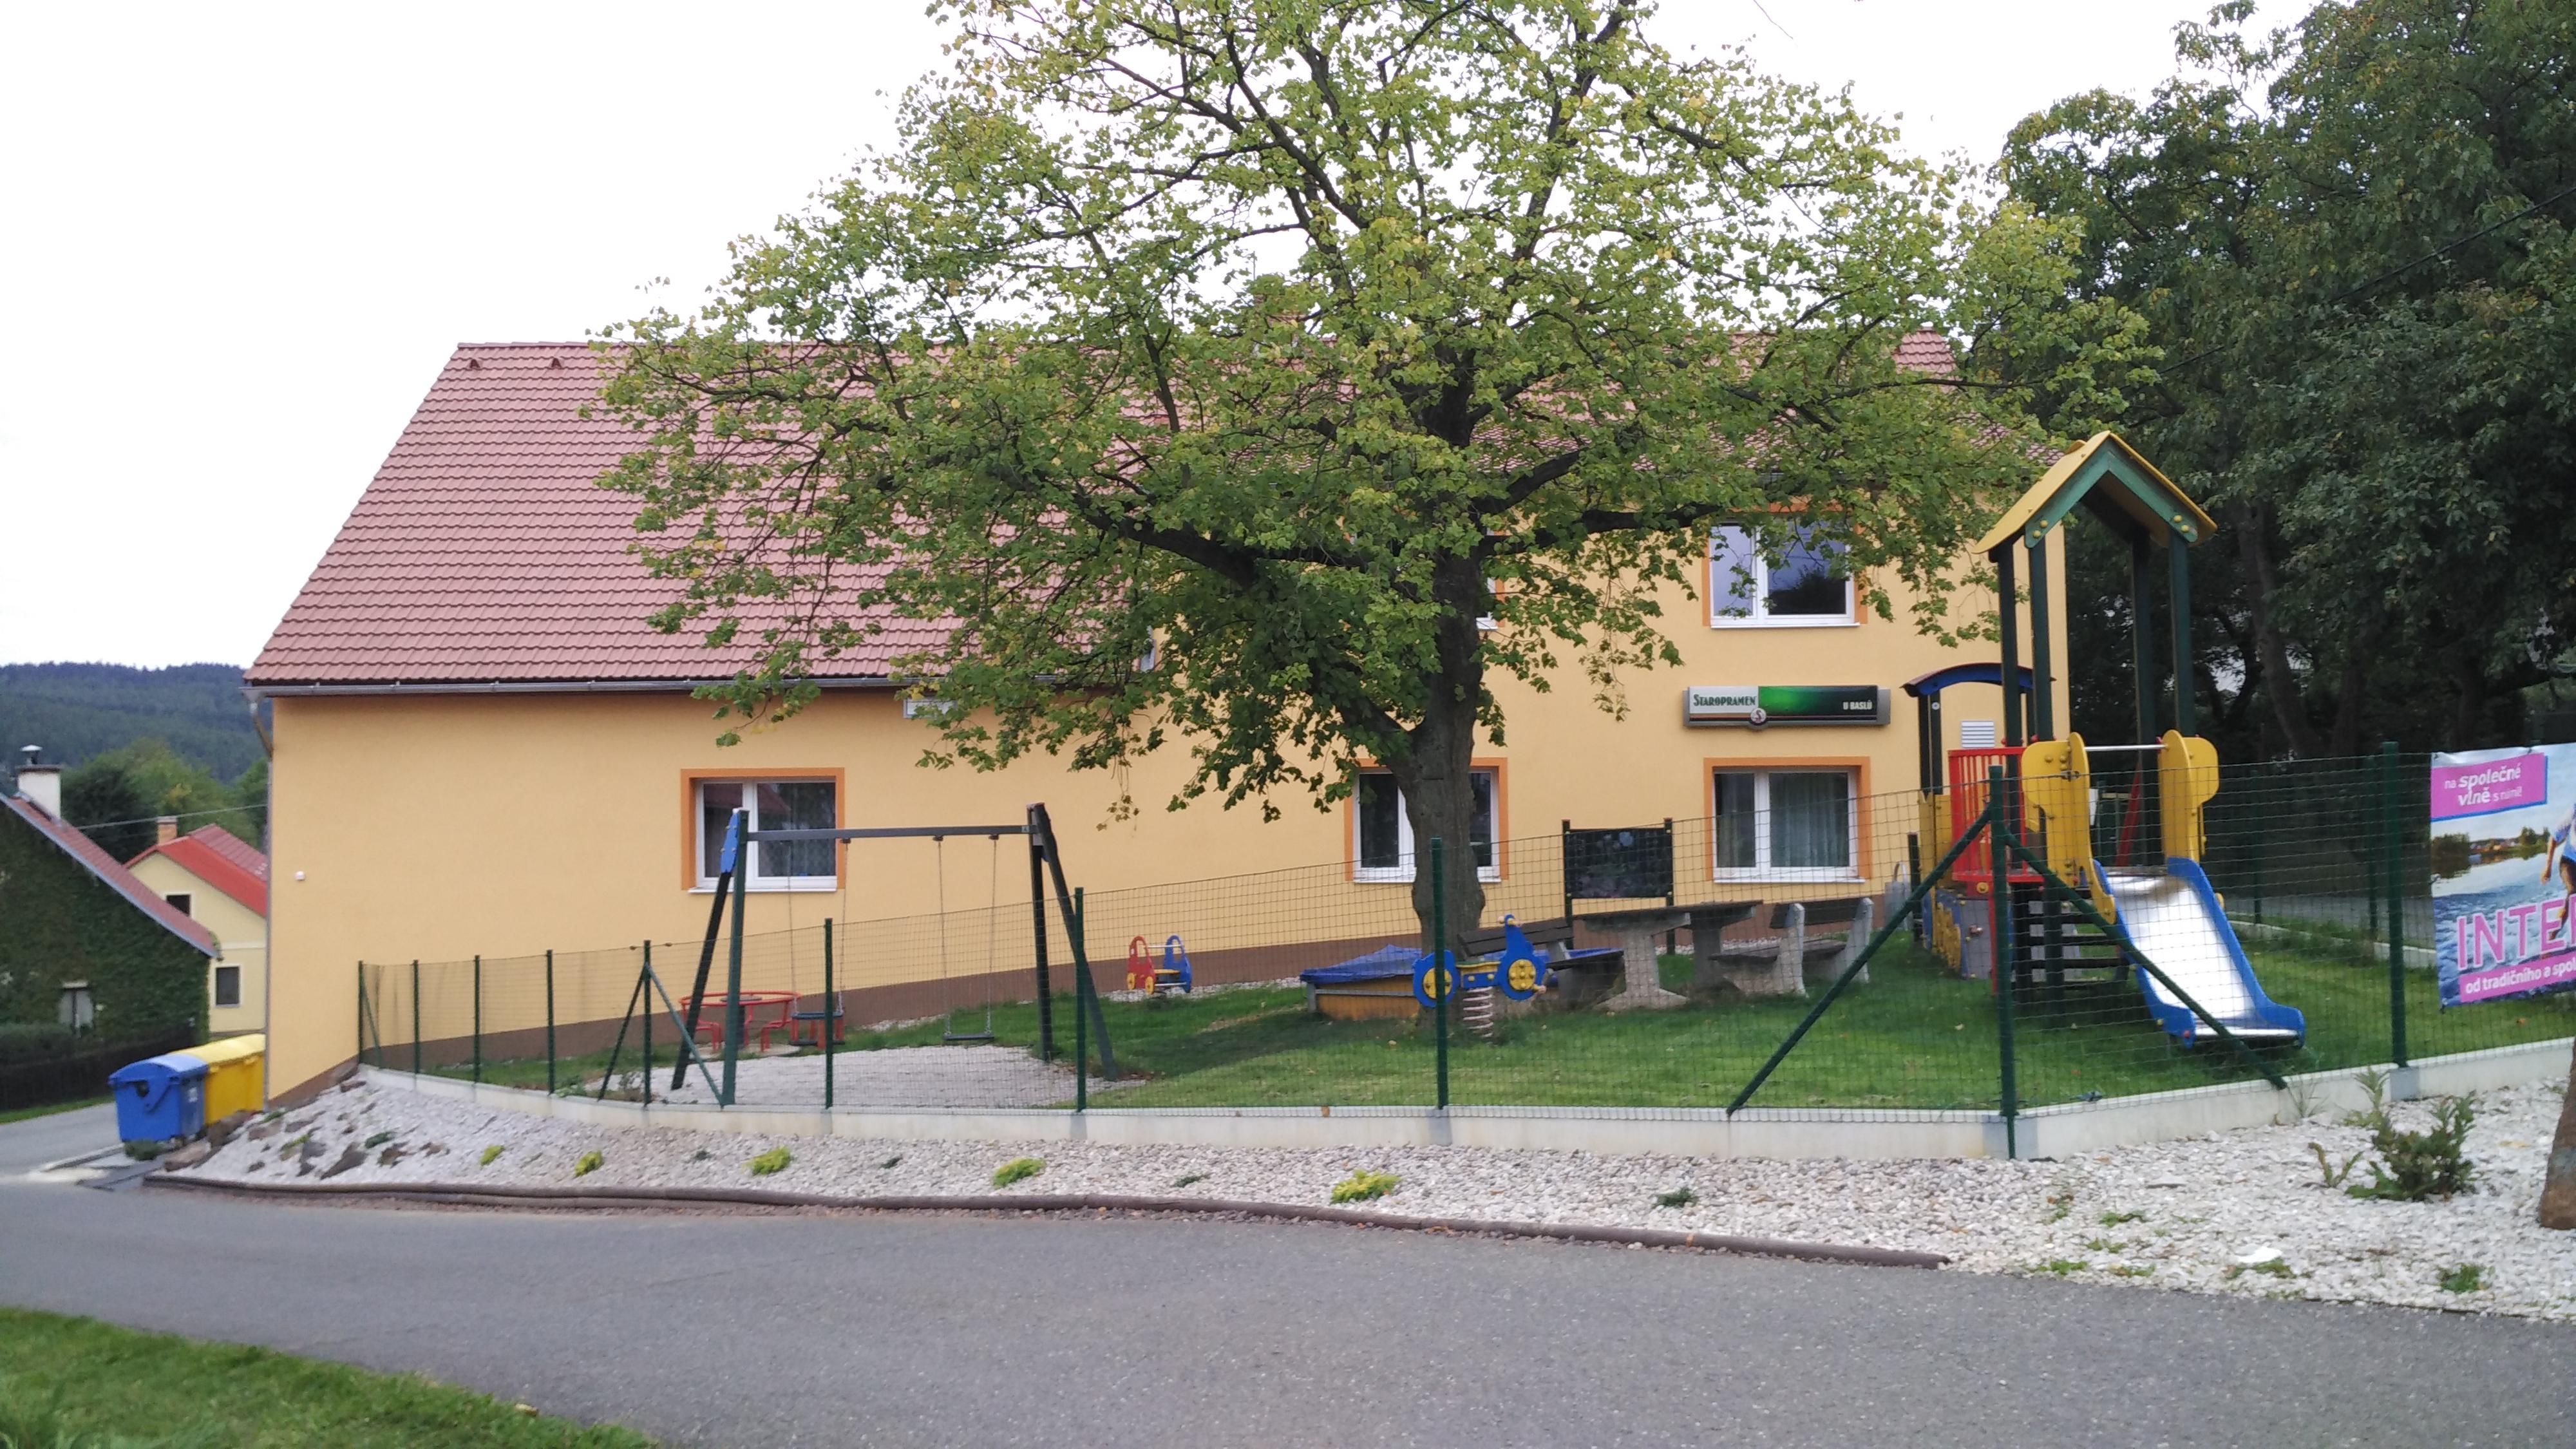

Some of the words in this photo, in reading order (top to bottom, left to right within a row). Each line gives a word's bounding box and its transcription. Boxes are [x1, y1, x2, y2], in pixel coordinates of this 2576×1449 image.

[1693, 694, 1756, 706] STAROPRAMEN
[1842, 701, 1849, 710] U
[2445, 780, 2457, 789] na
[2458, 762, 2522, 790] společné
[2458, 787, 2491, 806] vlně
[2493, 792, 2499, 801] s
[2457, 893, 2576, 971] INTE
[2465, 978, 2481, 994] od
[2483, 967, 2542, 990] tradičního
[2543, 966, 2551, 978] a
